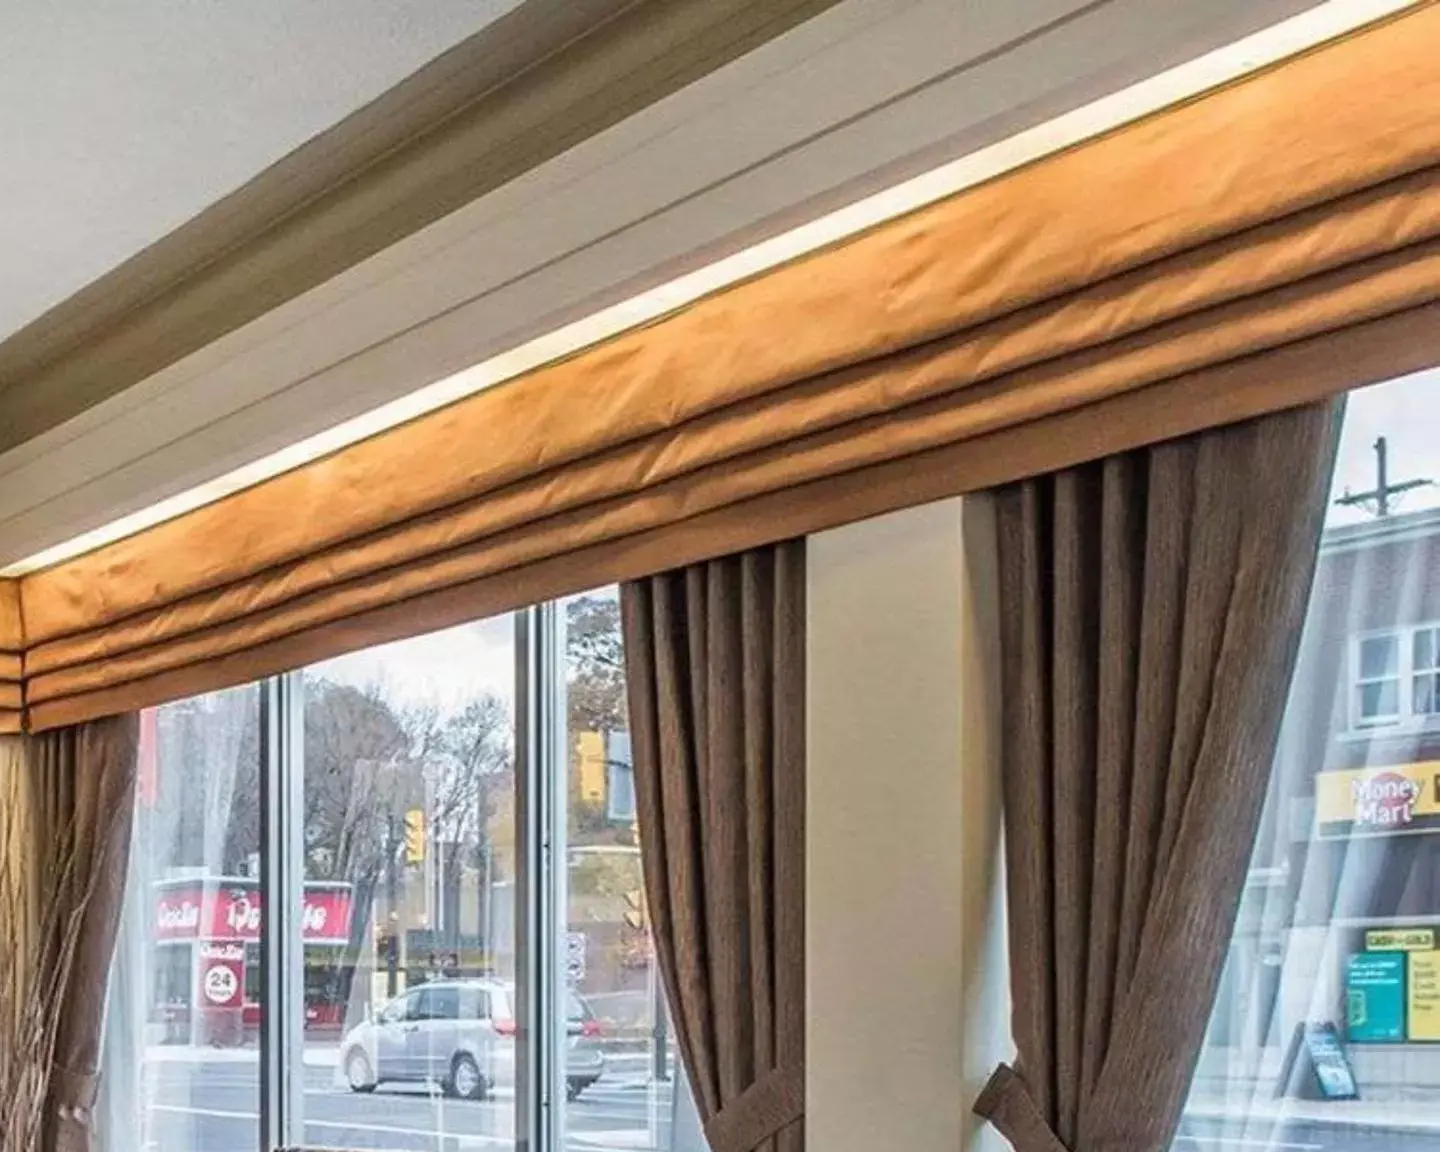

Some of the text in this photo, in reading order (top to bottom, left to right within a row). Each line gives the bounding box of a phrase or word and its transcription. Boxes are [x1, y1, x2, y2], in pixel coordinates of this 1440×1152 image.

[1351, 779, 1421, 803] Money
[1356, 801, 1413, 825] Mart
[210, 972, 231, 986] 24
